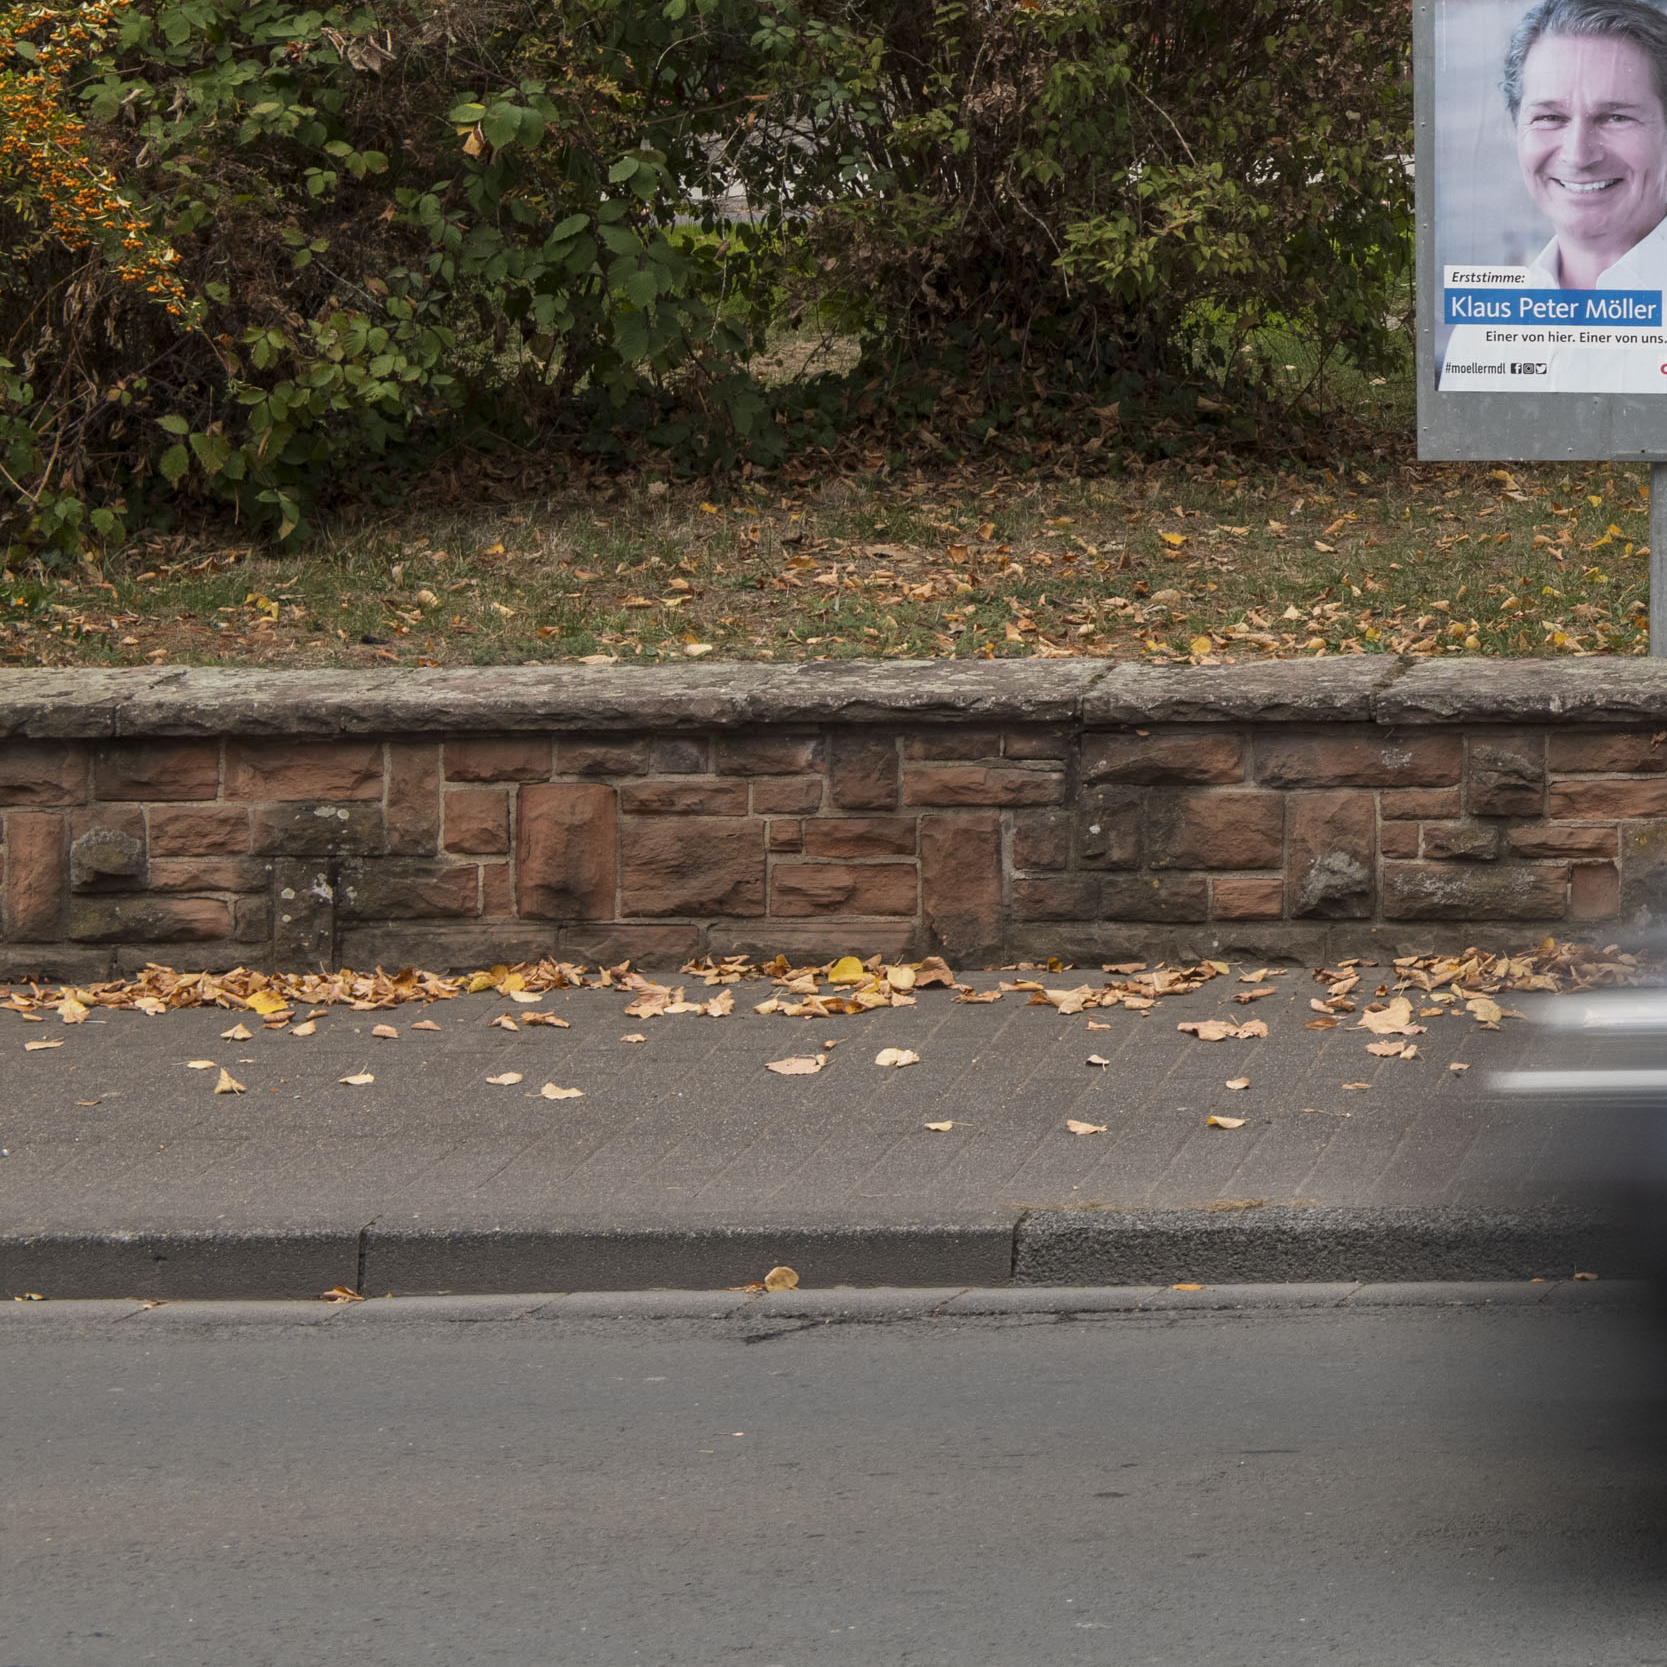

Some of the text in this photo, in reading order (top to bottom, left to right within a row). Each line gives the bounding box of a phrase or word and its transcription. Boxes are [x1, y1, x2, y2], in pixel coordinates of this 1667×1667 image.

[1452, 272, 1525, 284] Erststimme:
[1451, 296, 1656, 320] Klaus Peter Möller
[1445, 362, 1506, 375] #moellermdl
